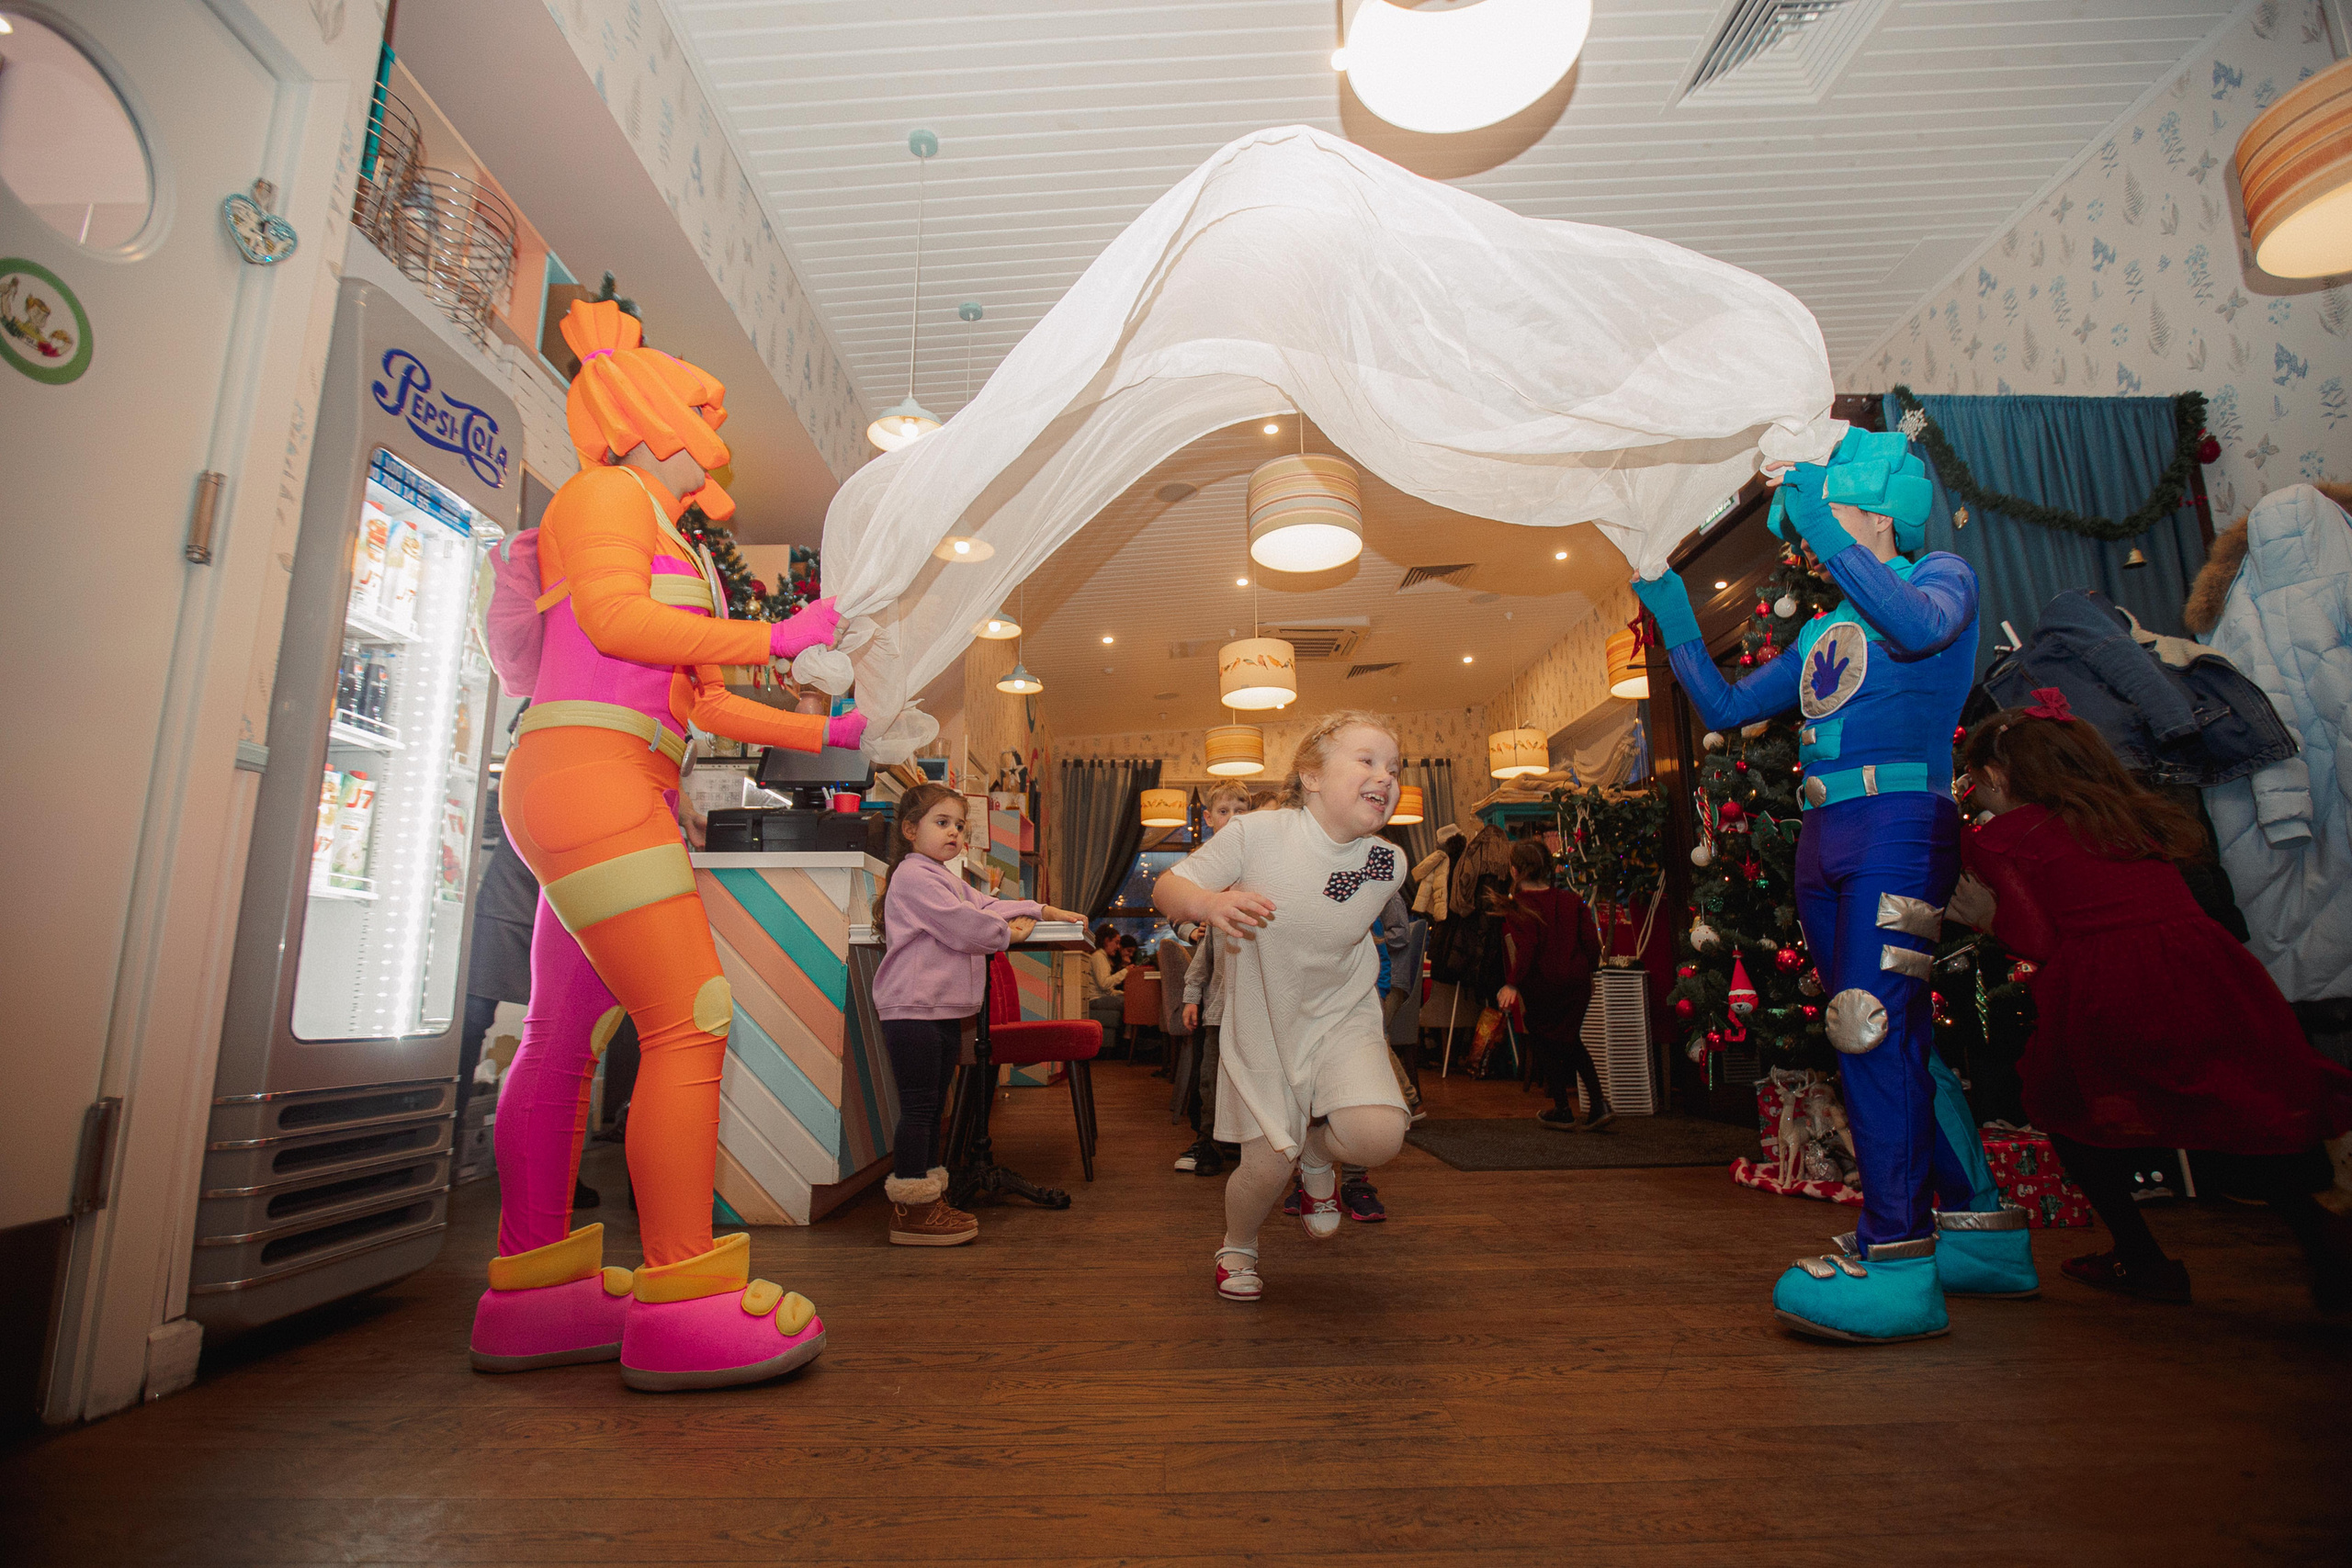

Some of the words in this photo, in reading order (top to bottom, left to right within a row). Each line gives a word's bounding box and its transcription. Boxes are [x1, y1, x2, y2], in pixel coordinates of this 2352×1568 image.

[381, 472, 401, 494] 700
[402, 486, 414, 502] 14
[416, 494, 431, 512] 55
[345, 788, 375, 809] J7
